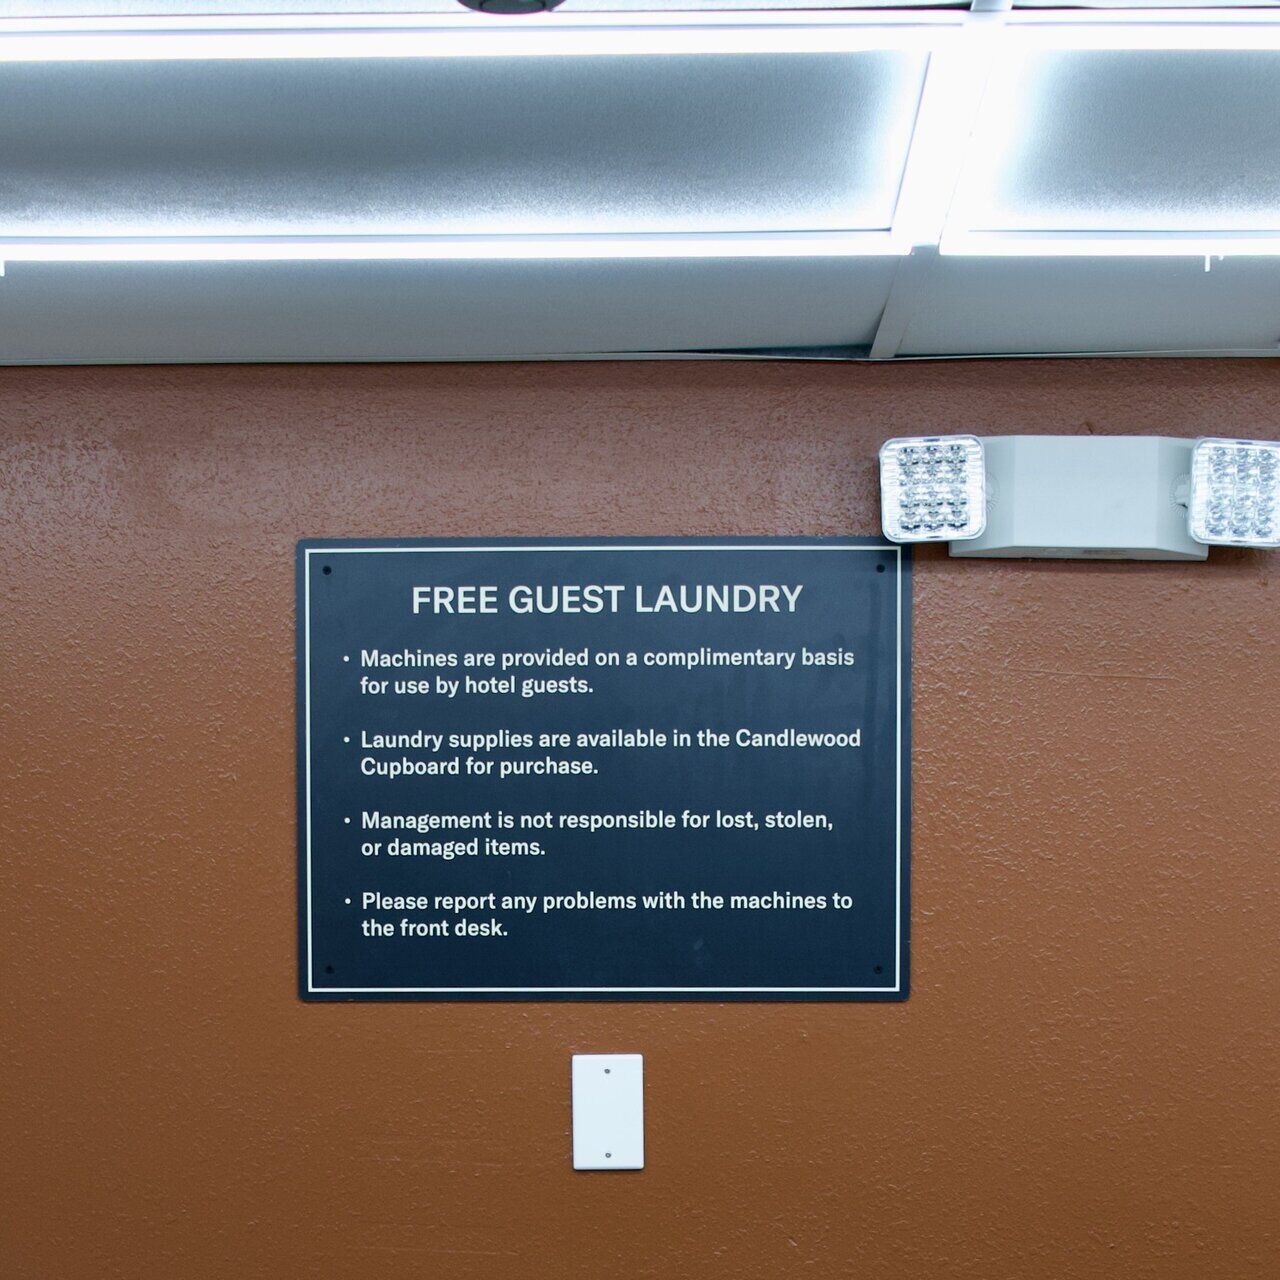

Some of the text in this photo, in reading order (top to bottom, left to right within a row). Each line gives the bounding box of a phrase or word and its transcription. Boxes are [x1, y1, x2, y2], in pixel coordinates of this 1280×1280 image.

[412, 584, 804, 615] FREE GUEST LAUNDRY
[360, 646, 855, 671] Machines are provided on a complimentary basis
[359, 674, 594, 699] for use by hotel guests.
[361, 727, 861, 753] Laundry supplies are available in the Candlewood
[360, 755, 599, 780] Cupboard for purchase.
[361, 809, 833, 834] Management is not responsible for lost, stolen,
[361, 837, 546, 861] or damaged items.
[362, 890, 853, 914] Please report any problems with the machines to
[361, 918, 508, 937] the front desk.
